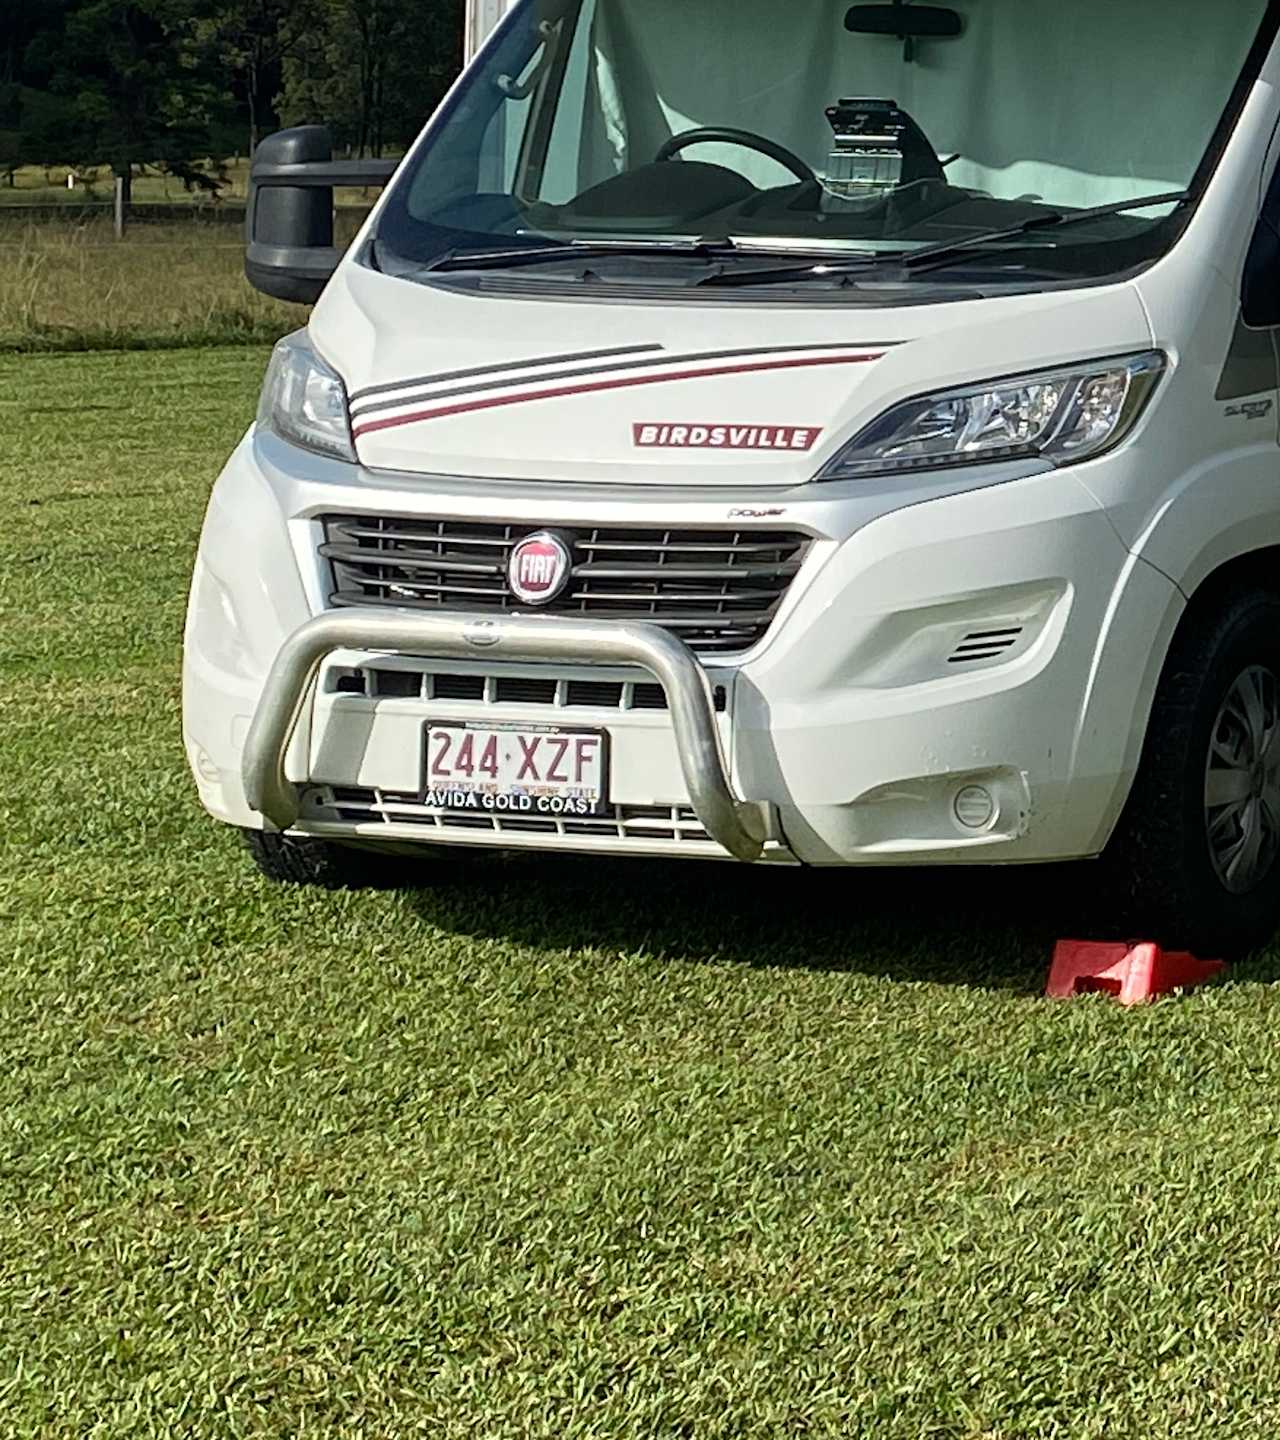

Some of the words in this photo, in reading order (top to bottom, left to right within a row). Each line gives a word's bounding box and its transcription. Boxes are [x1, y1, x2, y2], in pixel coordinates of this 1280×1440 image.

[639, 425, 809, 448] BIRDSVILLE
[521, 554, 556, 584] FIAT
[431, 731, 499, 779] 244
[516, 735, 599, 783] XZF
[425, 791, 477, 807] AVIDA
[482, 793, 531, 810] GOLD
[537, 797, 599, 814] COAST
